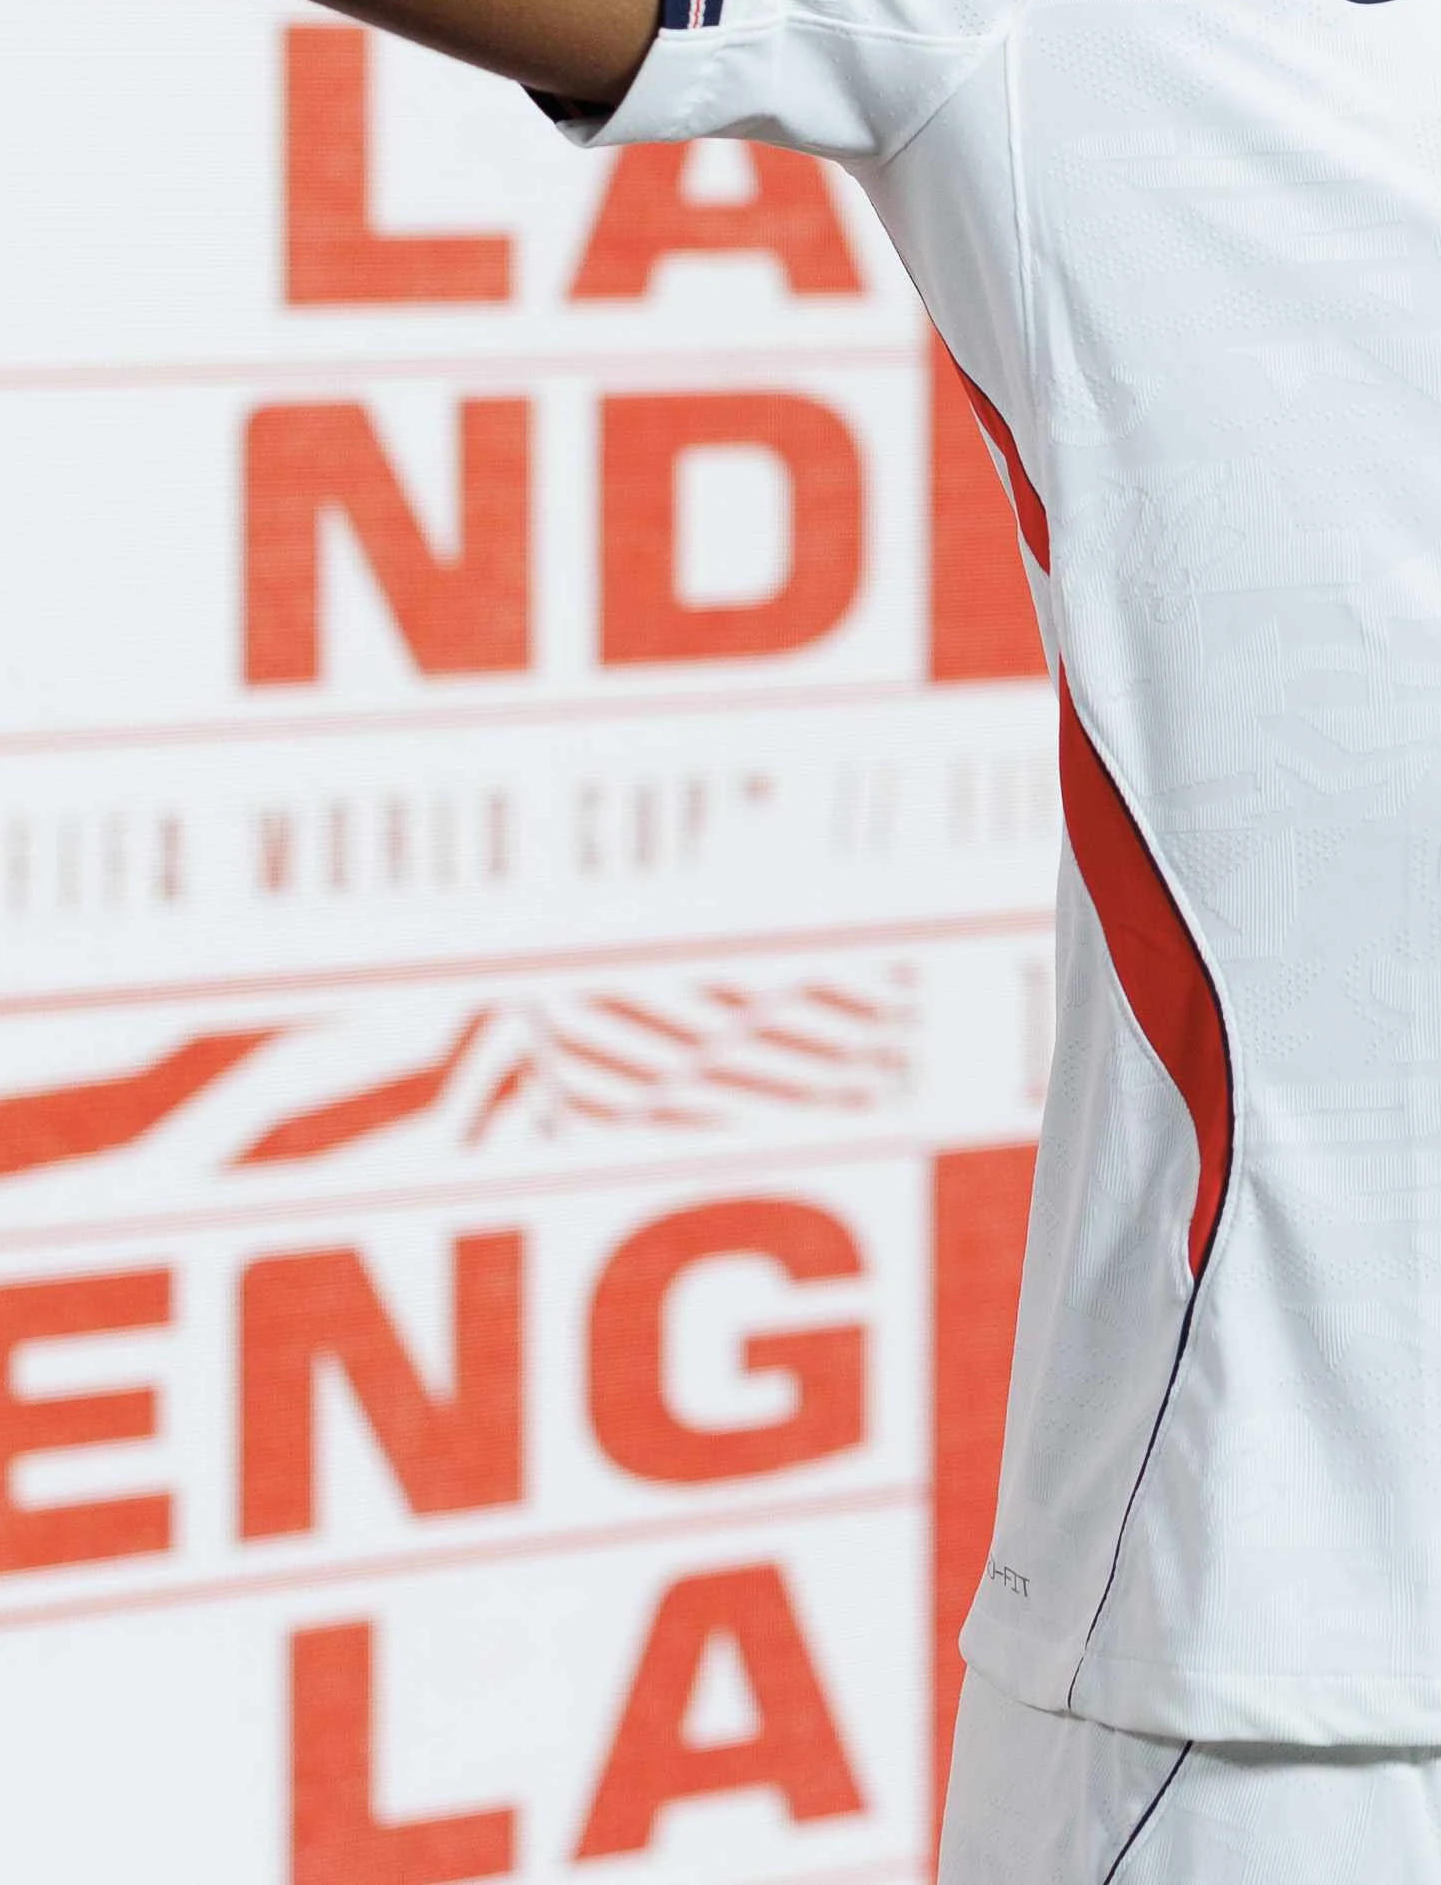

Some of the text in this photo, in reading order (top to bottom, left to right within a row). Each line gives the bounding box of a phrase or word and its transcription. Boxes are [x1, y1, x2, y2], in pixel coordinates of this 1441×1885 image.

[281, 22, 865, 307] LA
[242, 388, 867, 688] ND
[288, 1561, 867, 1885] LA
